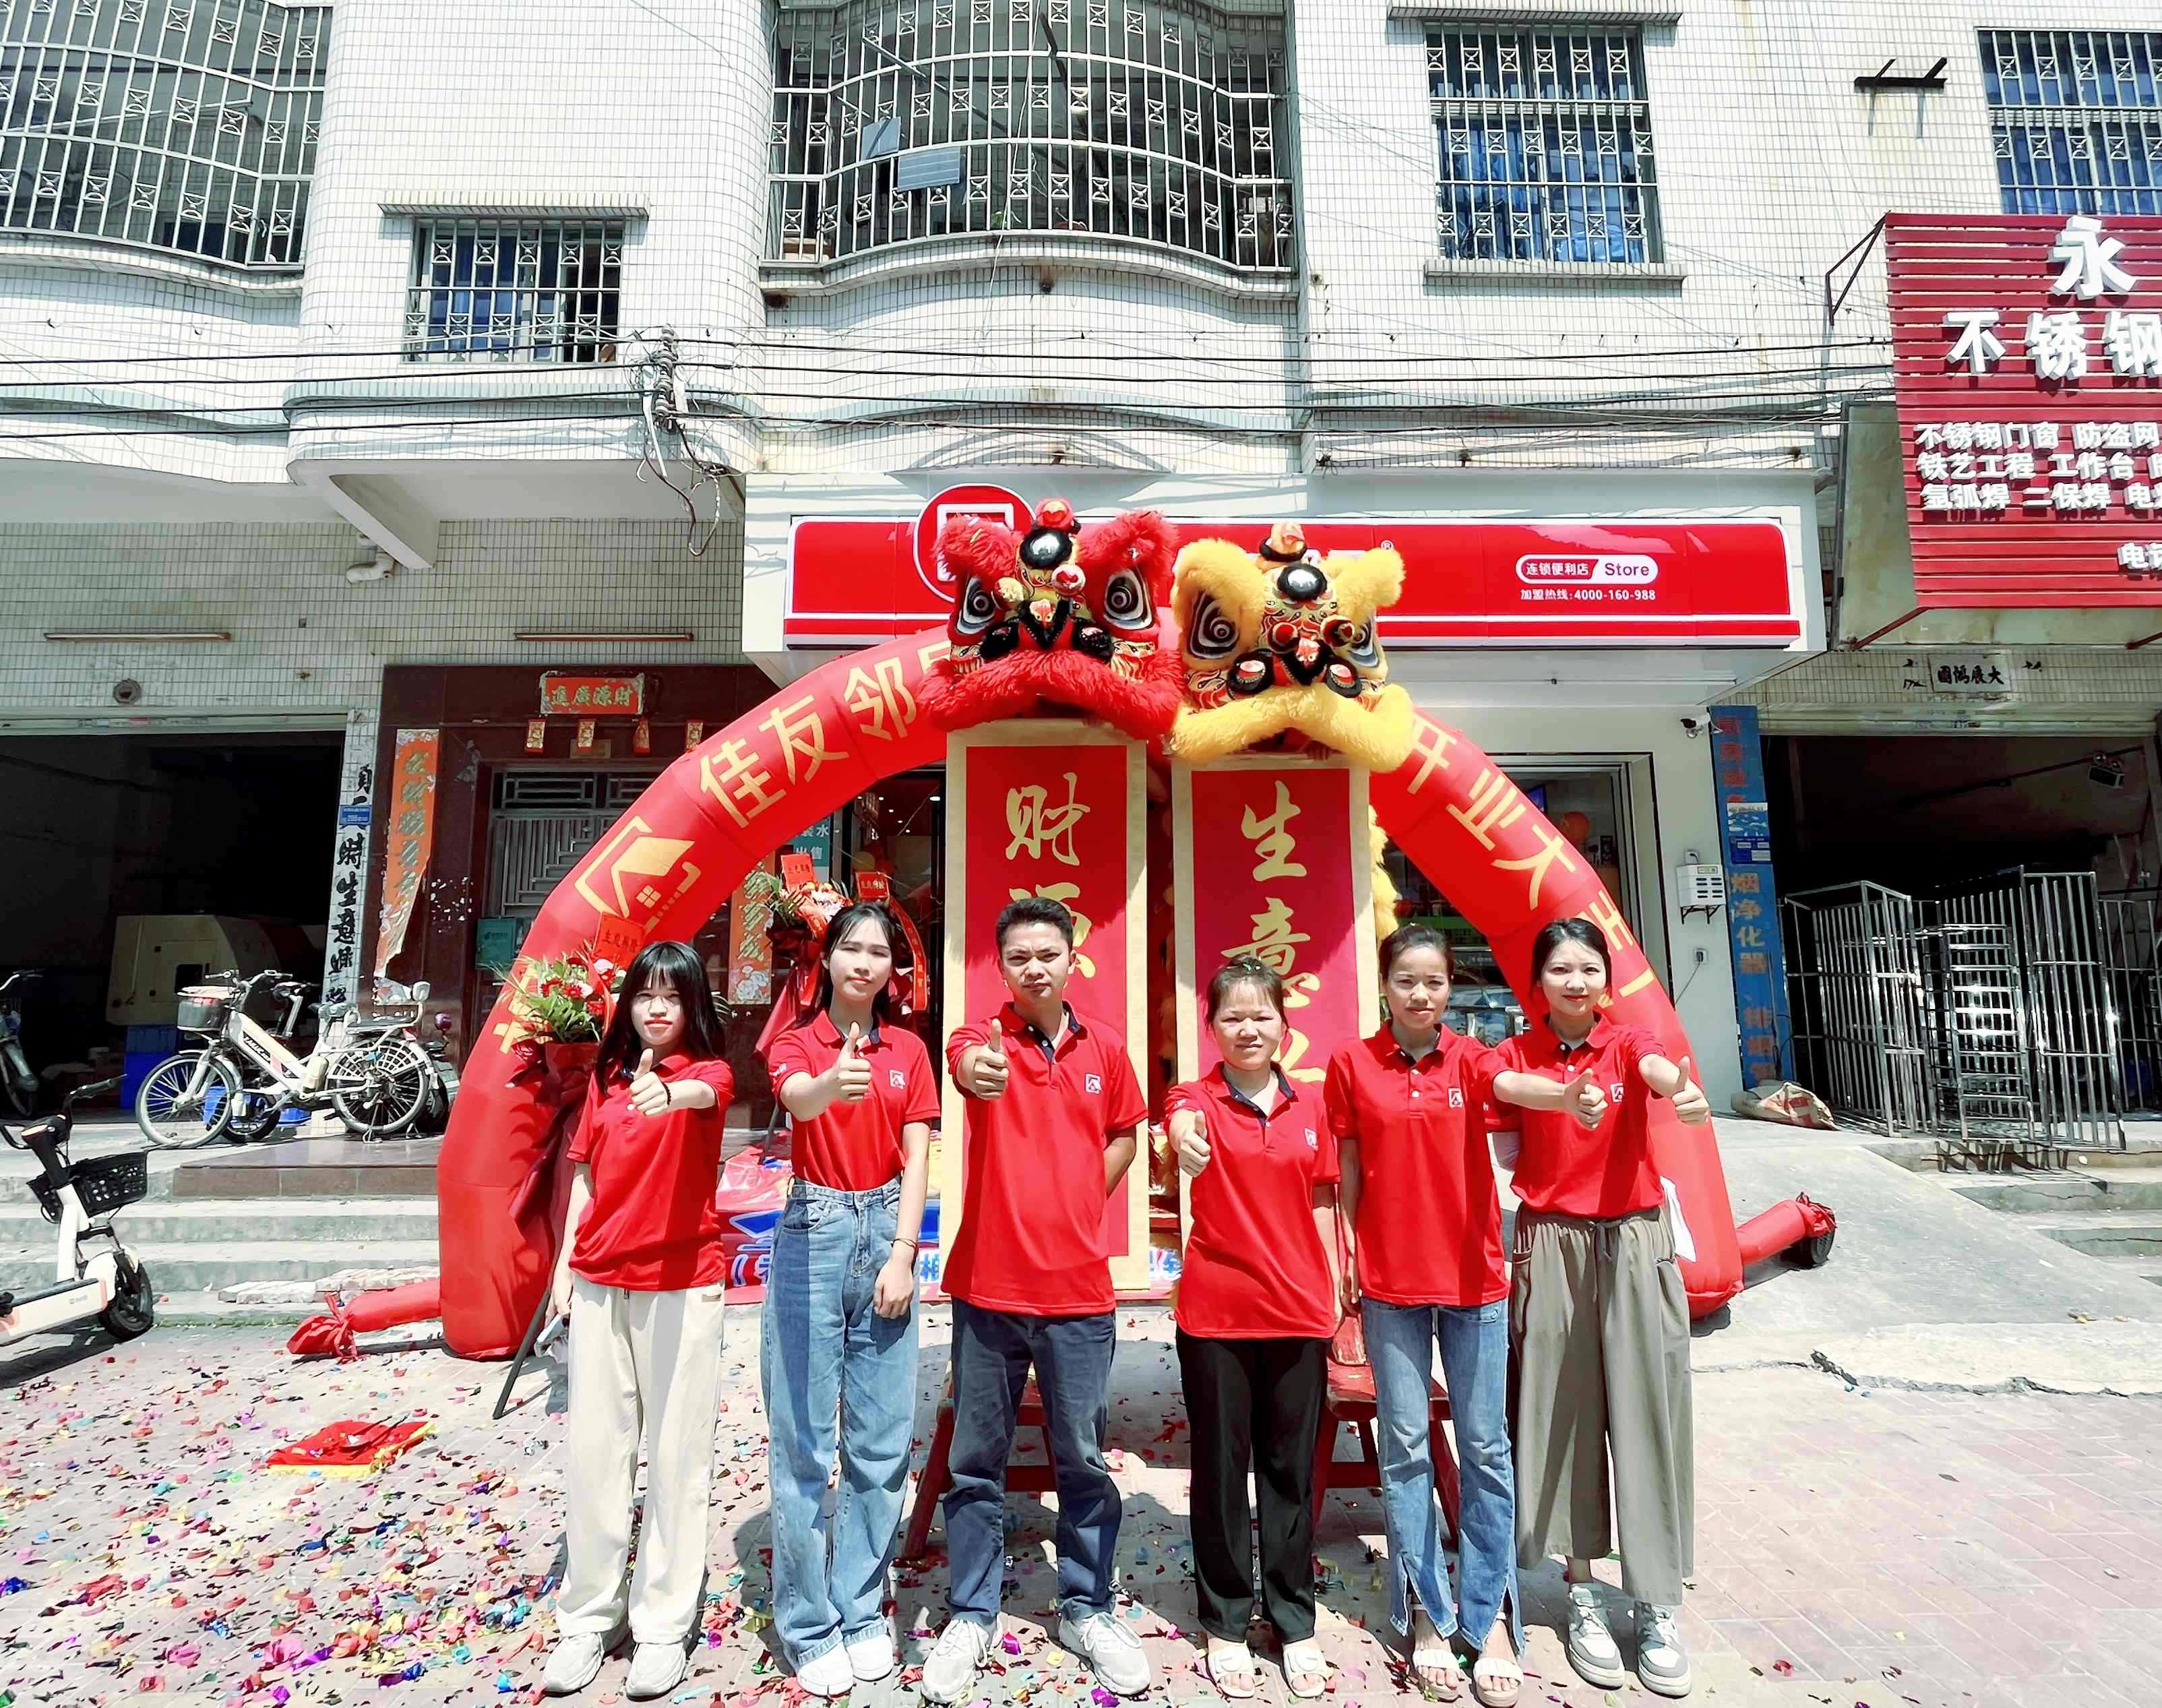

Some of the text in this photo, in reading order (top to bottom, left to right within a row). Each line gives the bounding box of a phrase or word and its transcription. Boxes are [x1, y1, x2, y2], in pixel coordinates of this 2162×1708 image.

[2048, 215, 2137, 300] 永
[1942, 310, 2162, 380] 不锈钢
[1914, 421, 2160, 450] 不锈钢门窗 防盗网
[1917, 452, 2036, 480] 铁艺工程
[2047, 452, 2135, 481] 工作台
[1920, 483, 2011, 510] 氩弧焊
[2022, 482, 2111, 510] 二保焊
[1526, 562, 1589, 576] 连锁便利店
[1605, 563, 1650, 576] Store
[700, 640, 952, 828] 佳友邻
